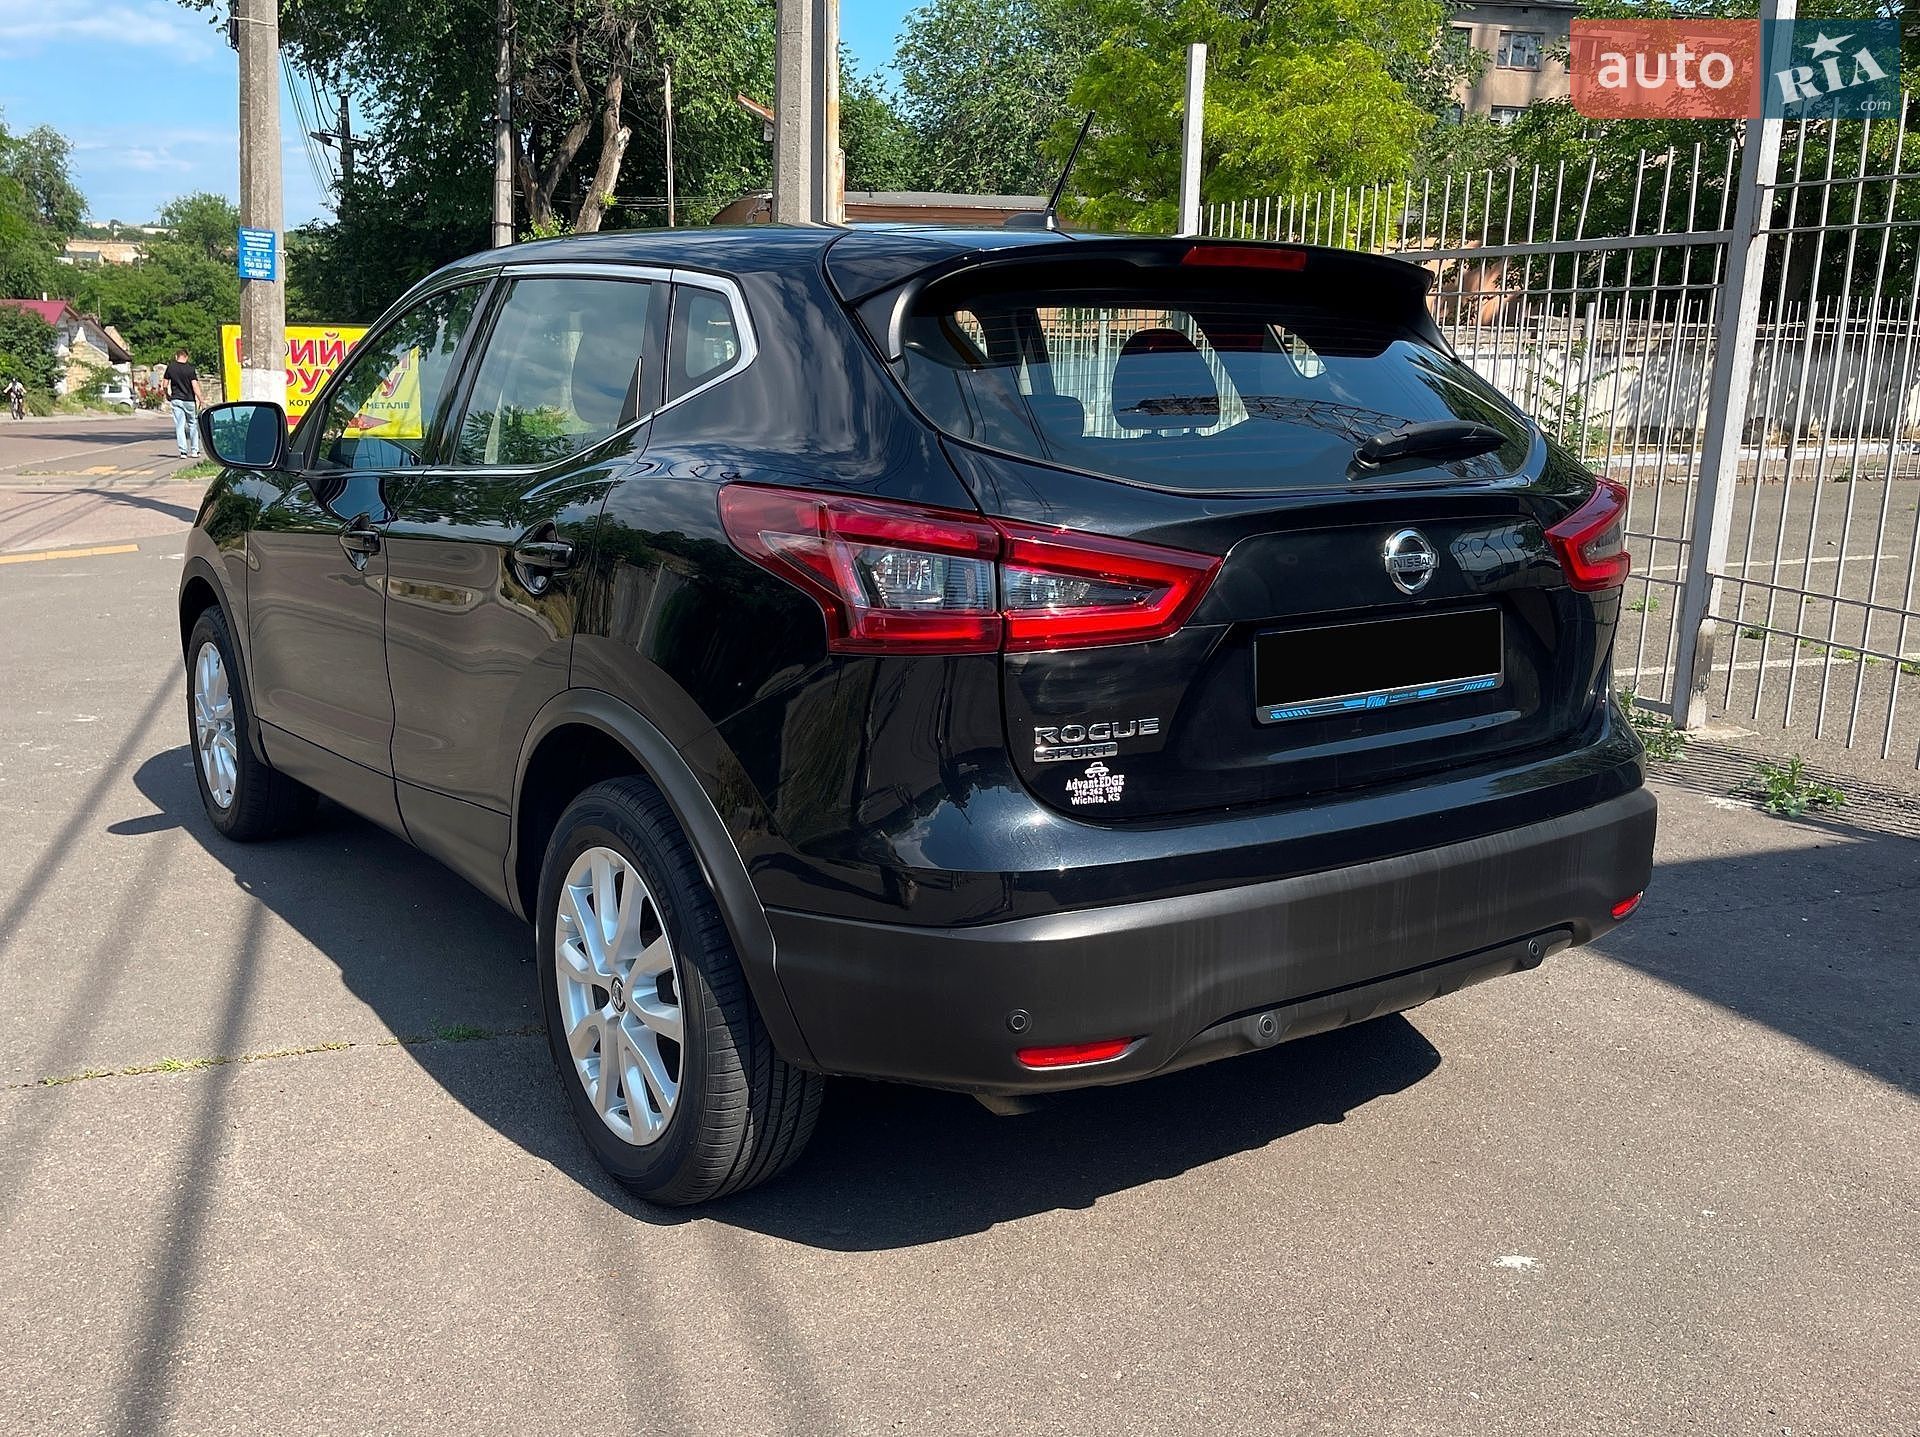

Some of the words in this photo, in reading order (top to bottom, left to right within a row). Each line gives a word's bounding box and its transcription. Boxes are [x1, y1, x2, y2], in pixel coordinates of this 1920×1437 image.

[366, 401, 410, 409] МЕТАЛІВ
[1034, 717, 1160, 745] ROGUE
[1043, 744, 1113, 760] SPORT
[1065, 774, 1125, 791] AdvantEDGE
[1108, 792, 1121, 802] KS
